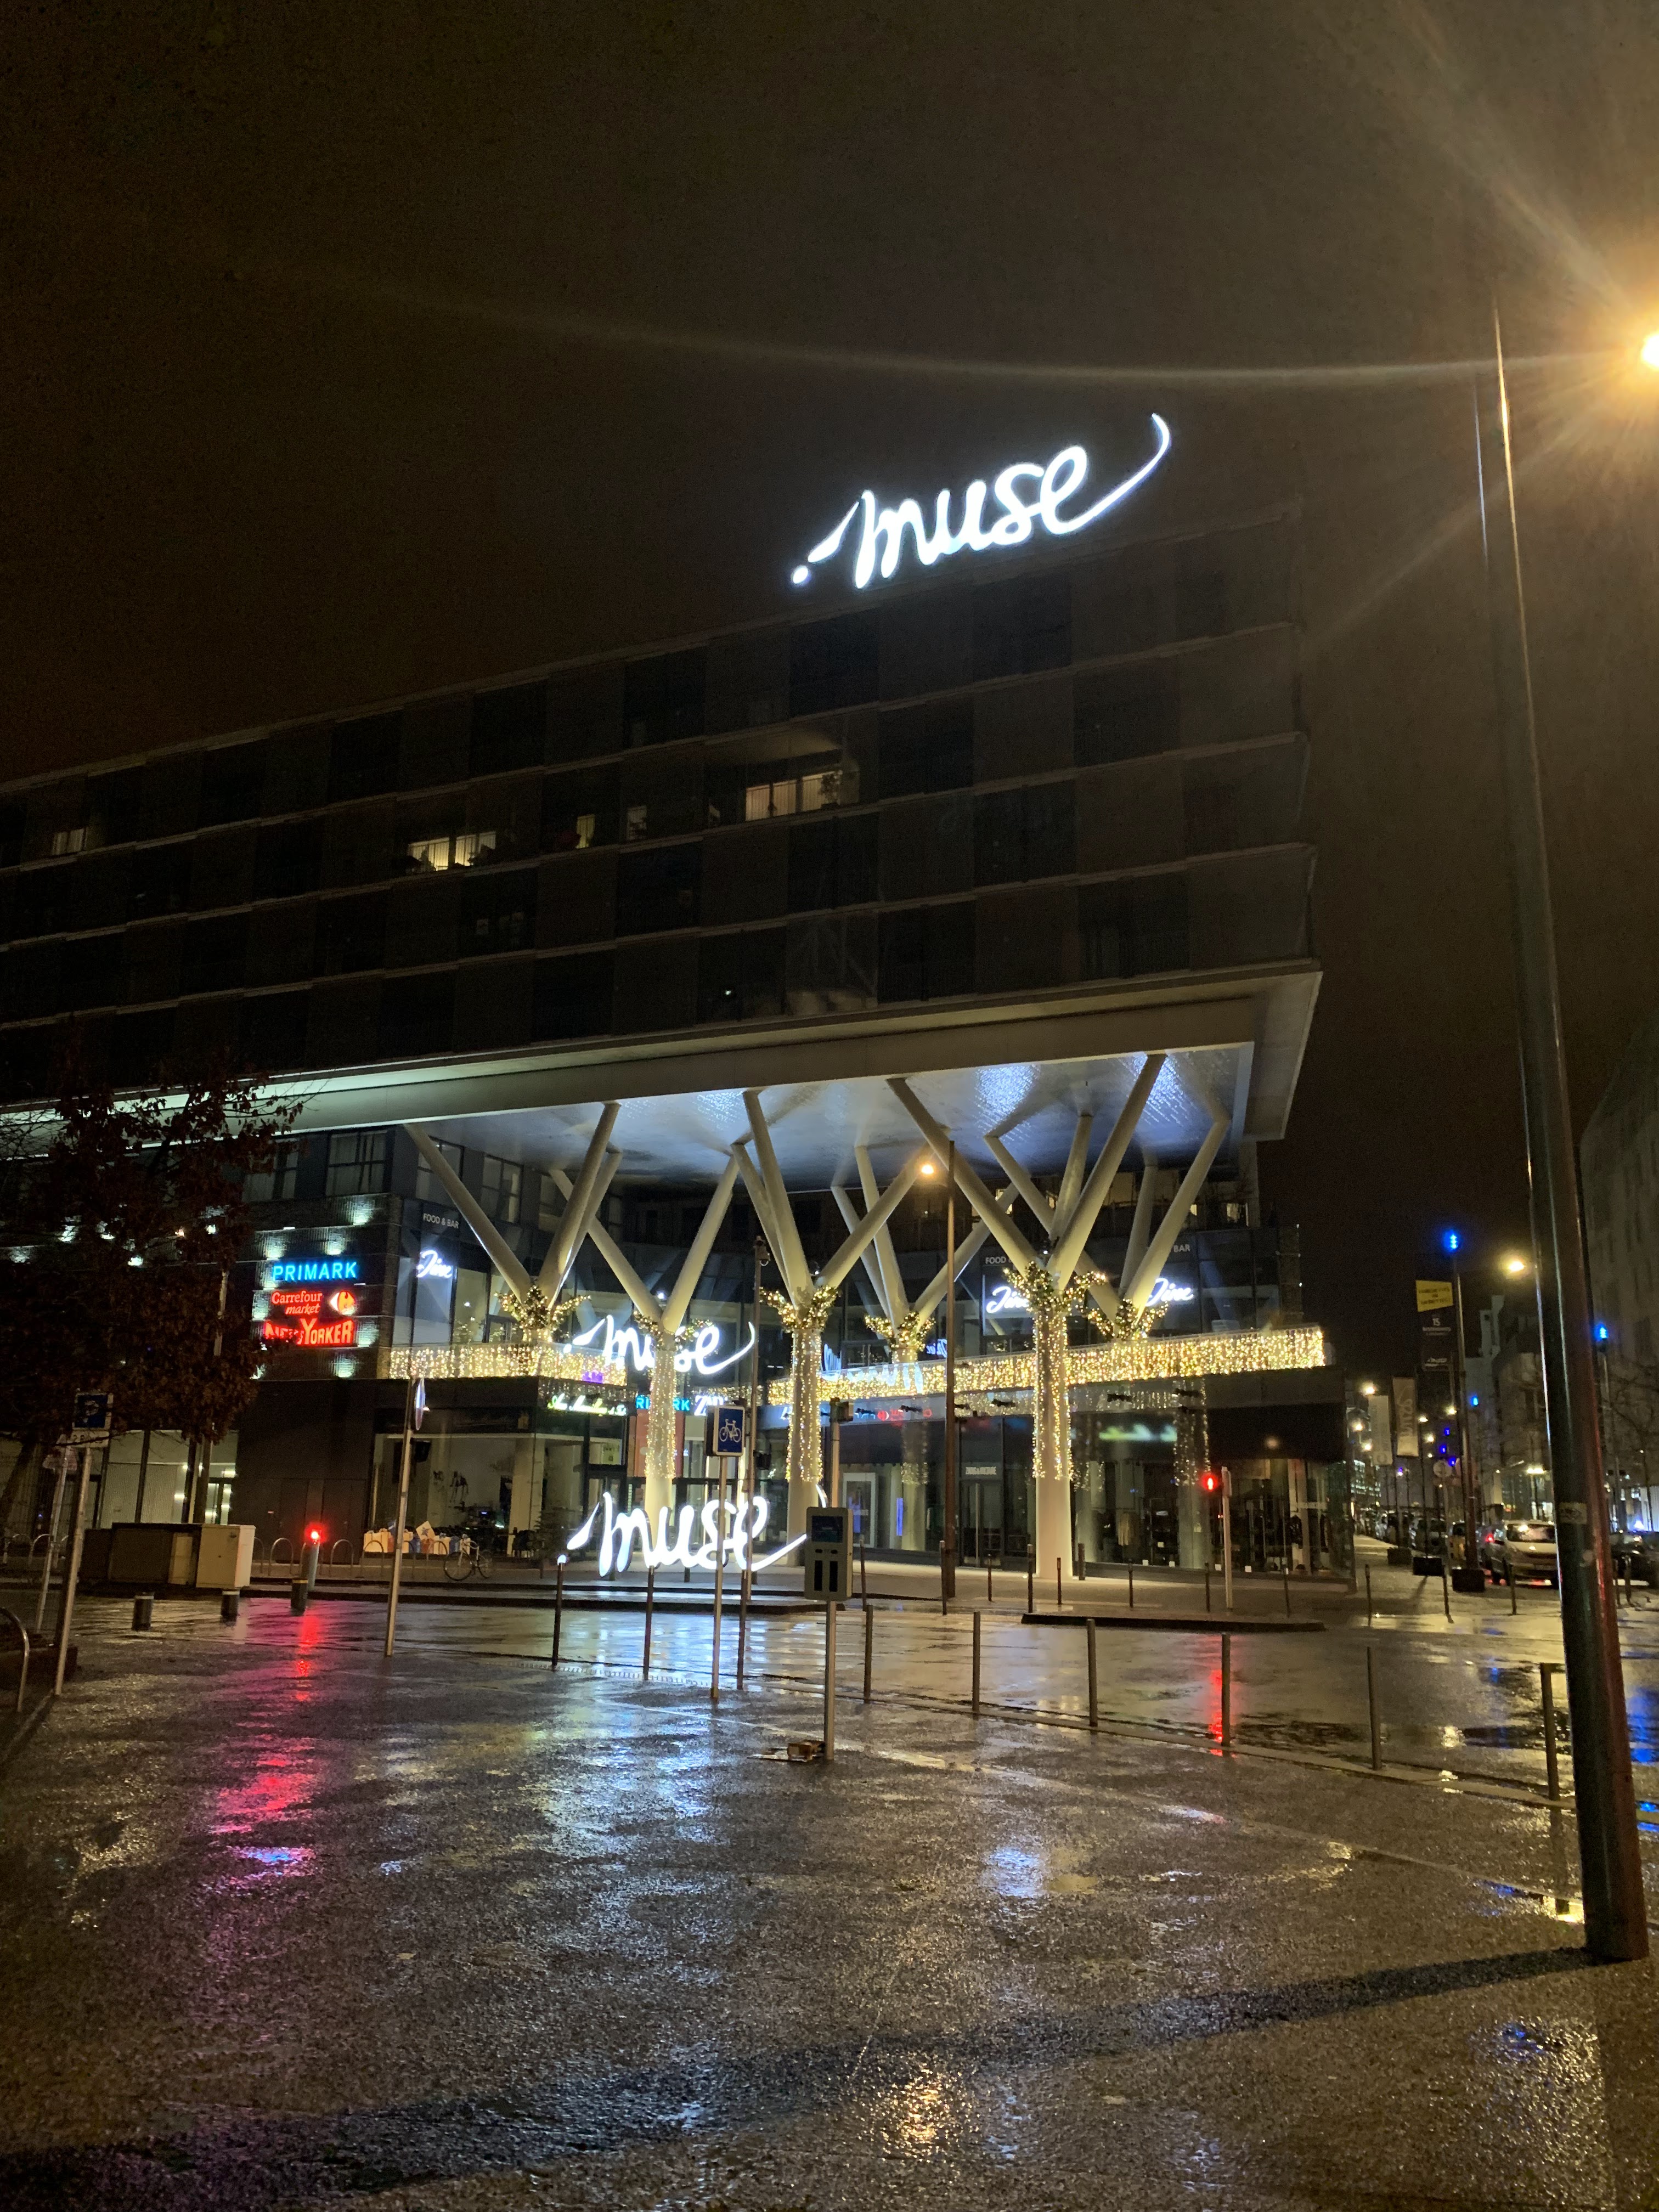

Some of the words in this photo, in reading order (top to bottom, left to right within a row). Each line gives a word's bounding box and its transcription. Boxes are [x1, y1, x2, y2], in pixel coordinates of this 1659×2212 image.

[791, 413, 1170, 589] muse
[424, 1214, 440, 1224] FOOD
[447, 1219, 459, 1228] BAR
[1173, 1244, 1190, 1252] BAR
[273, 1262, 357, 1280] PRIMARK
[272, 1291, 322, 1304] Carrefour
[285, 1304, 320, 1314] market
[300, 1318, 354, 1345] YORKER
[558, 1484, 827, 1577] muse
